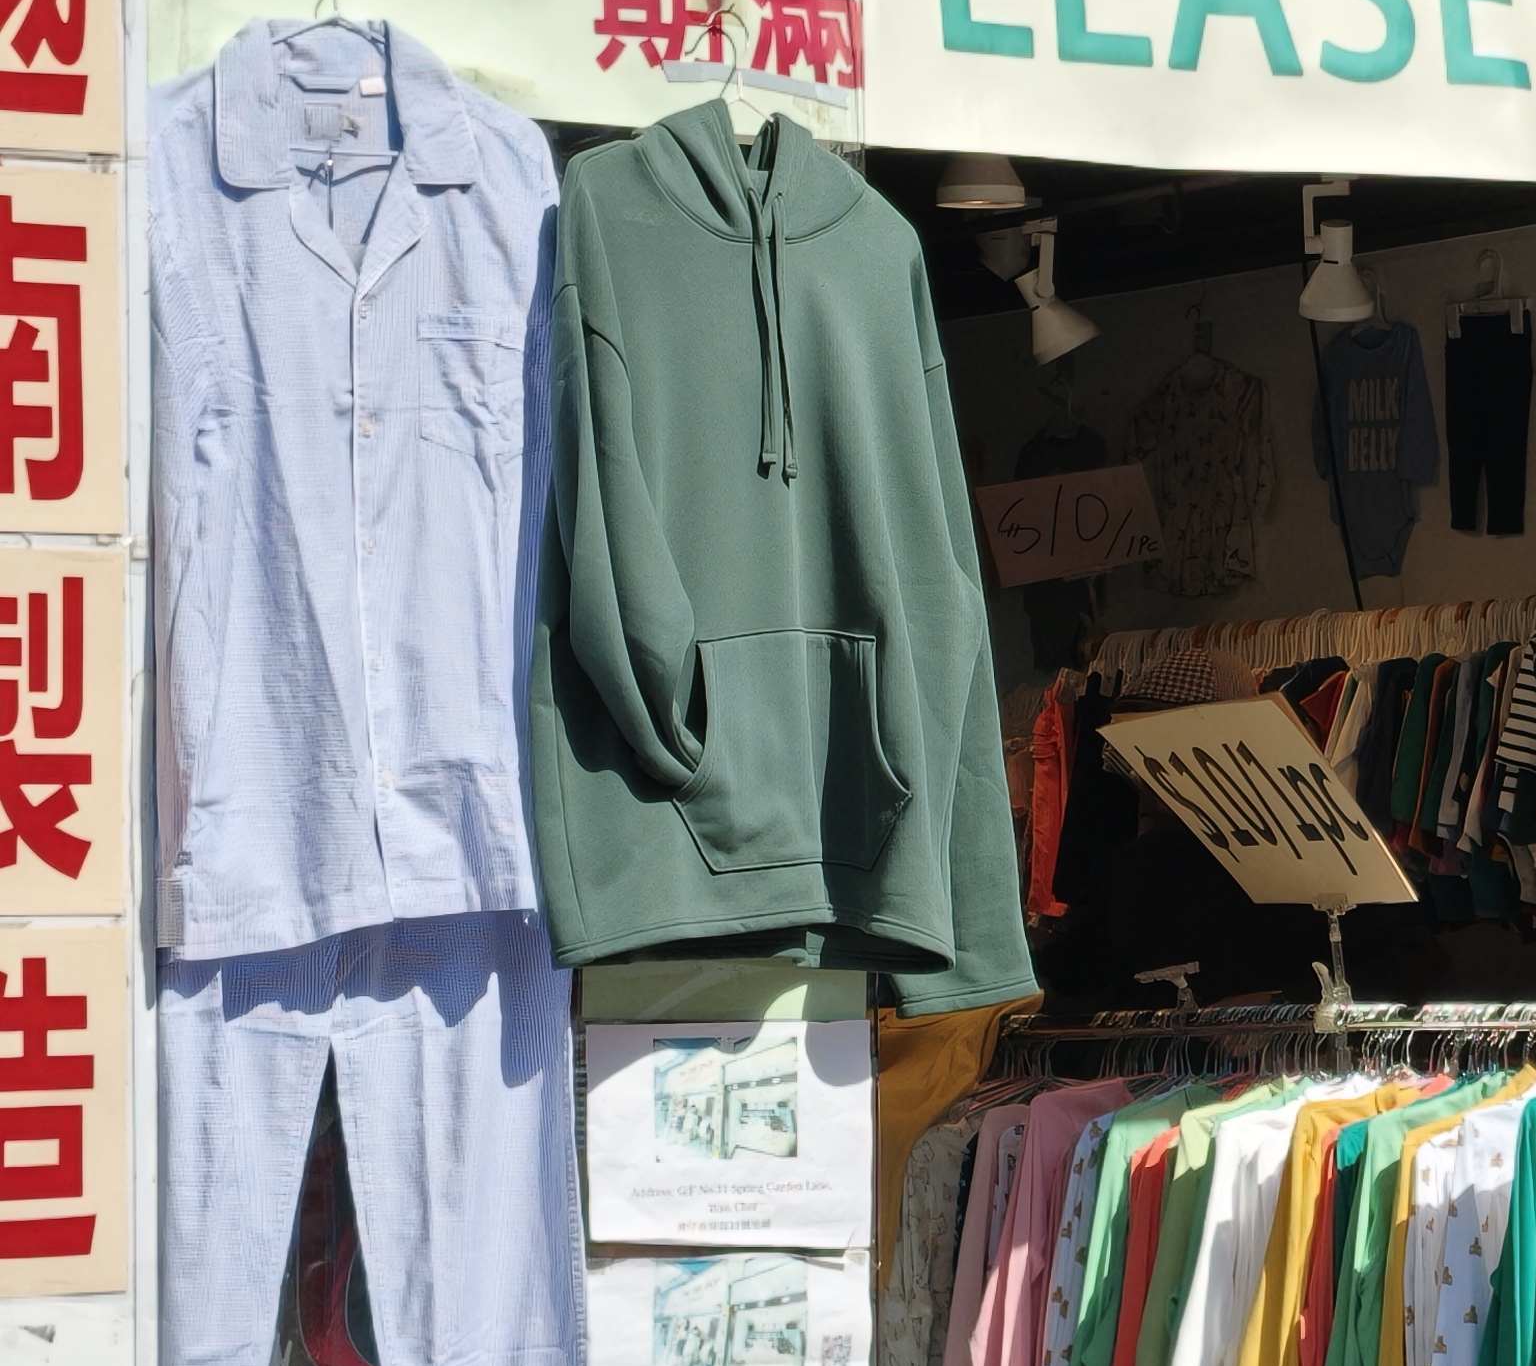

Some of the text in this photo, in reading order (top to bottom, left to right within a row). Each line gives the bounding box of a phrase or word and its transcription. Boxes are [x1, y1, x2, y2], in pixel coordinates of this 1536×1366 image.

[1347, 376, 1400, 423] MILK
[1347, 426, 1401, 473] BELLY
[1133, 740, 1370, 877] $10/1pc
